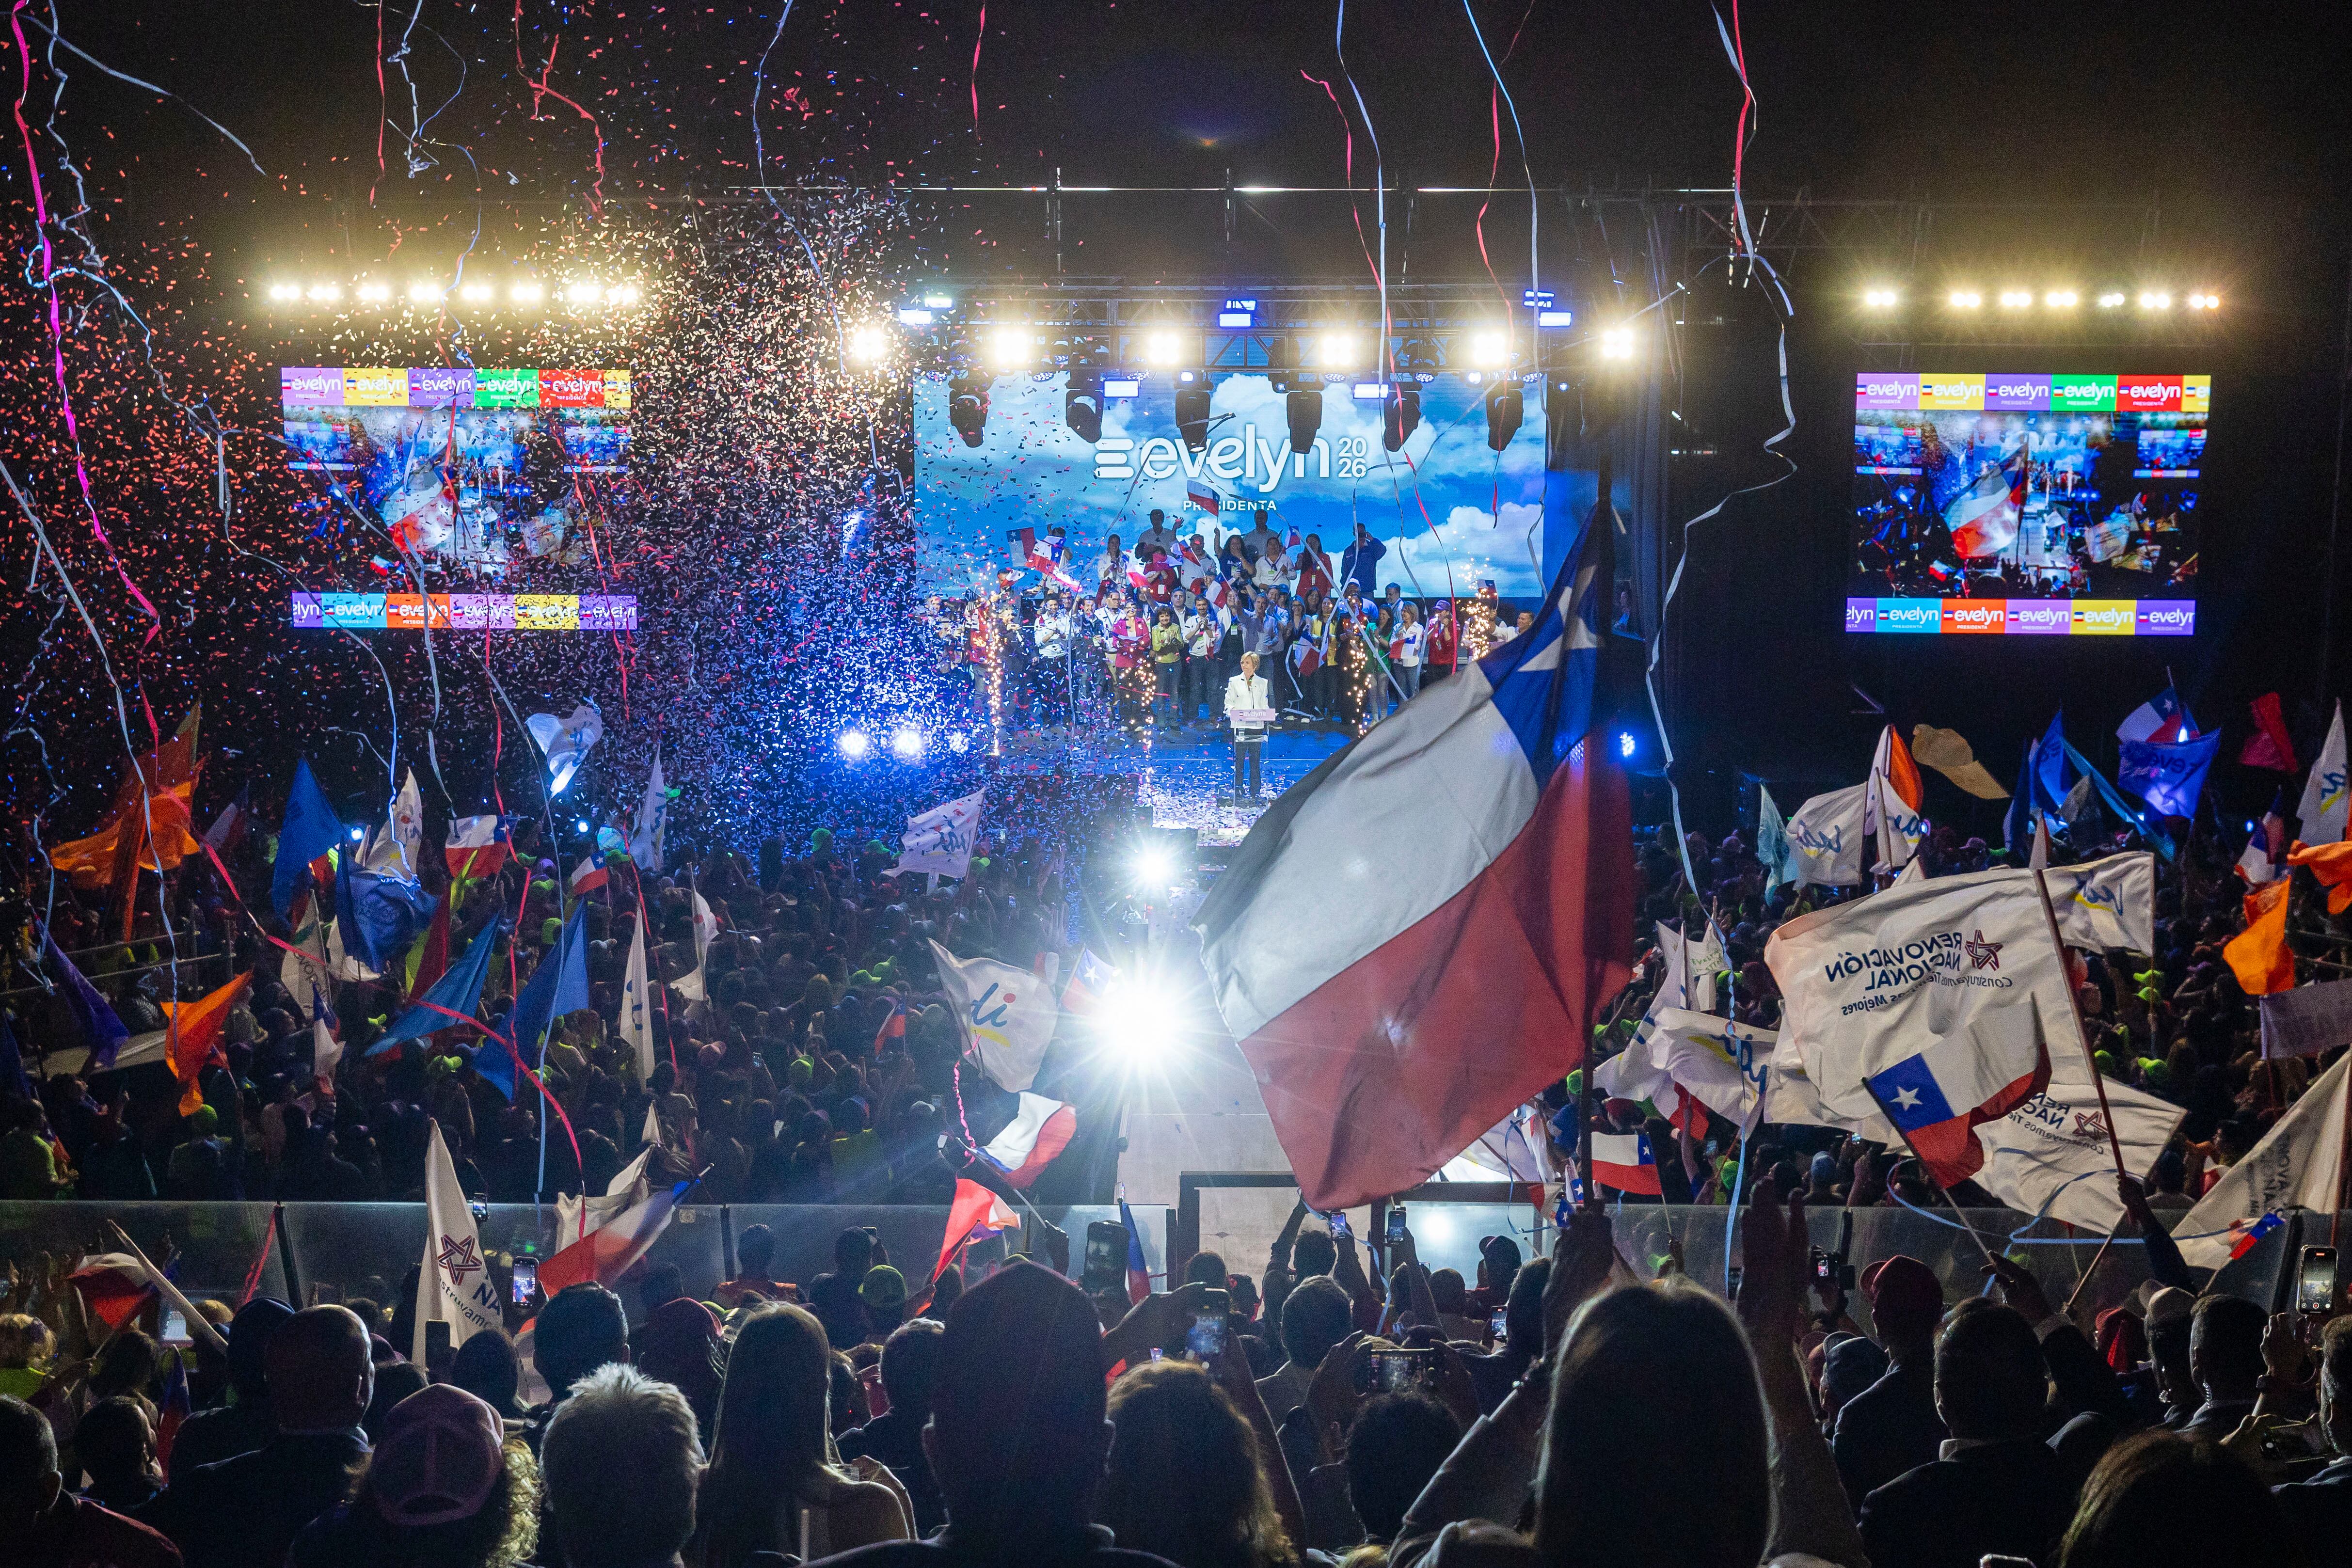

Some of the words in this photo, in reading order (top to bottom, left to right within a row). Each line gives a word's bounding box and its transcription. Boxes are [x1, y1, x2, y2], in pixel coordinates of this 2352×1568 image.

[291, 376, 341, 394] evelyn
[357, 376, 406, 395] evelyn
[422, 376, 471, 394] evelyn
[487, 377, 537, 396] evelyn
[553, 378, 602, 396] evelyn
[1867, 381, 1917, 399] evelyn
[1933, 381, 1983, 400] evelyn
[1999, 382, 2048, 400] evelyn
[2064, 382, 2114, 401] evelyn
[2130, 382, 2180, 402] evelyn
[1338, 437, 1367, 457] 20
[1140, 424, 1330, 492] evelyn
[1338, 458, 1367, 477] 26
[335, 601, 384, 619] evelyn
[1890, 606, 1939, 624] evelyn
[1955, 607, 2004, 625] evelyn
[2020, 607, 2069, 626] evelyn
[2084, 608, 2133, 626] evelyn
